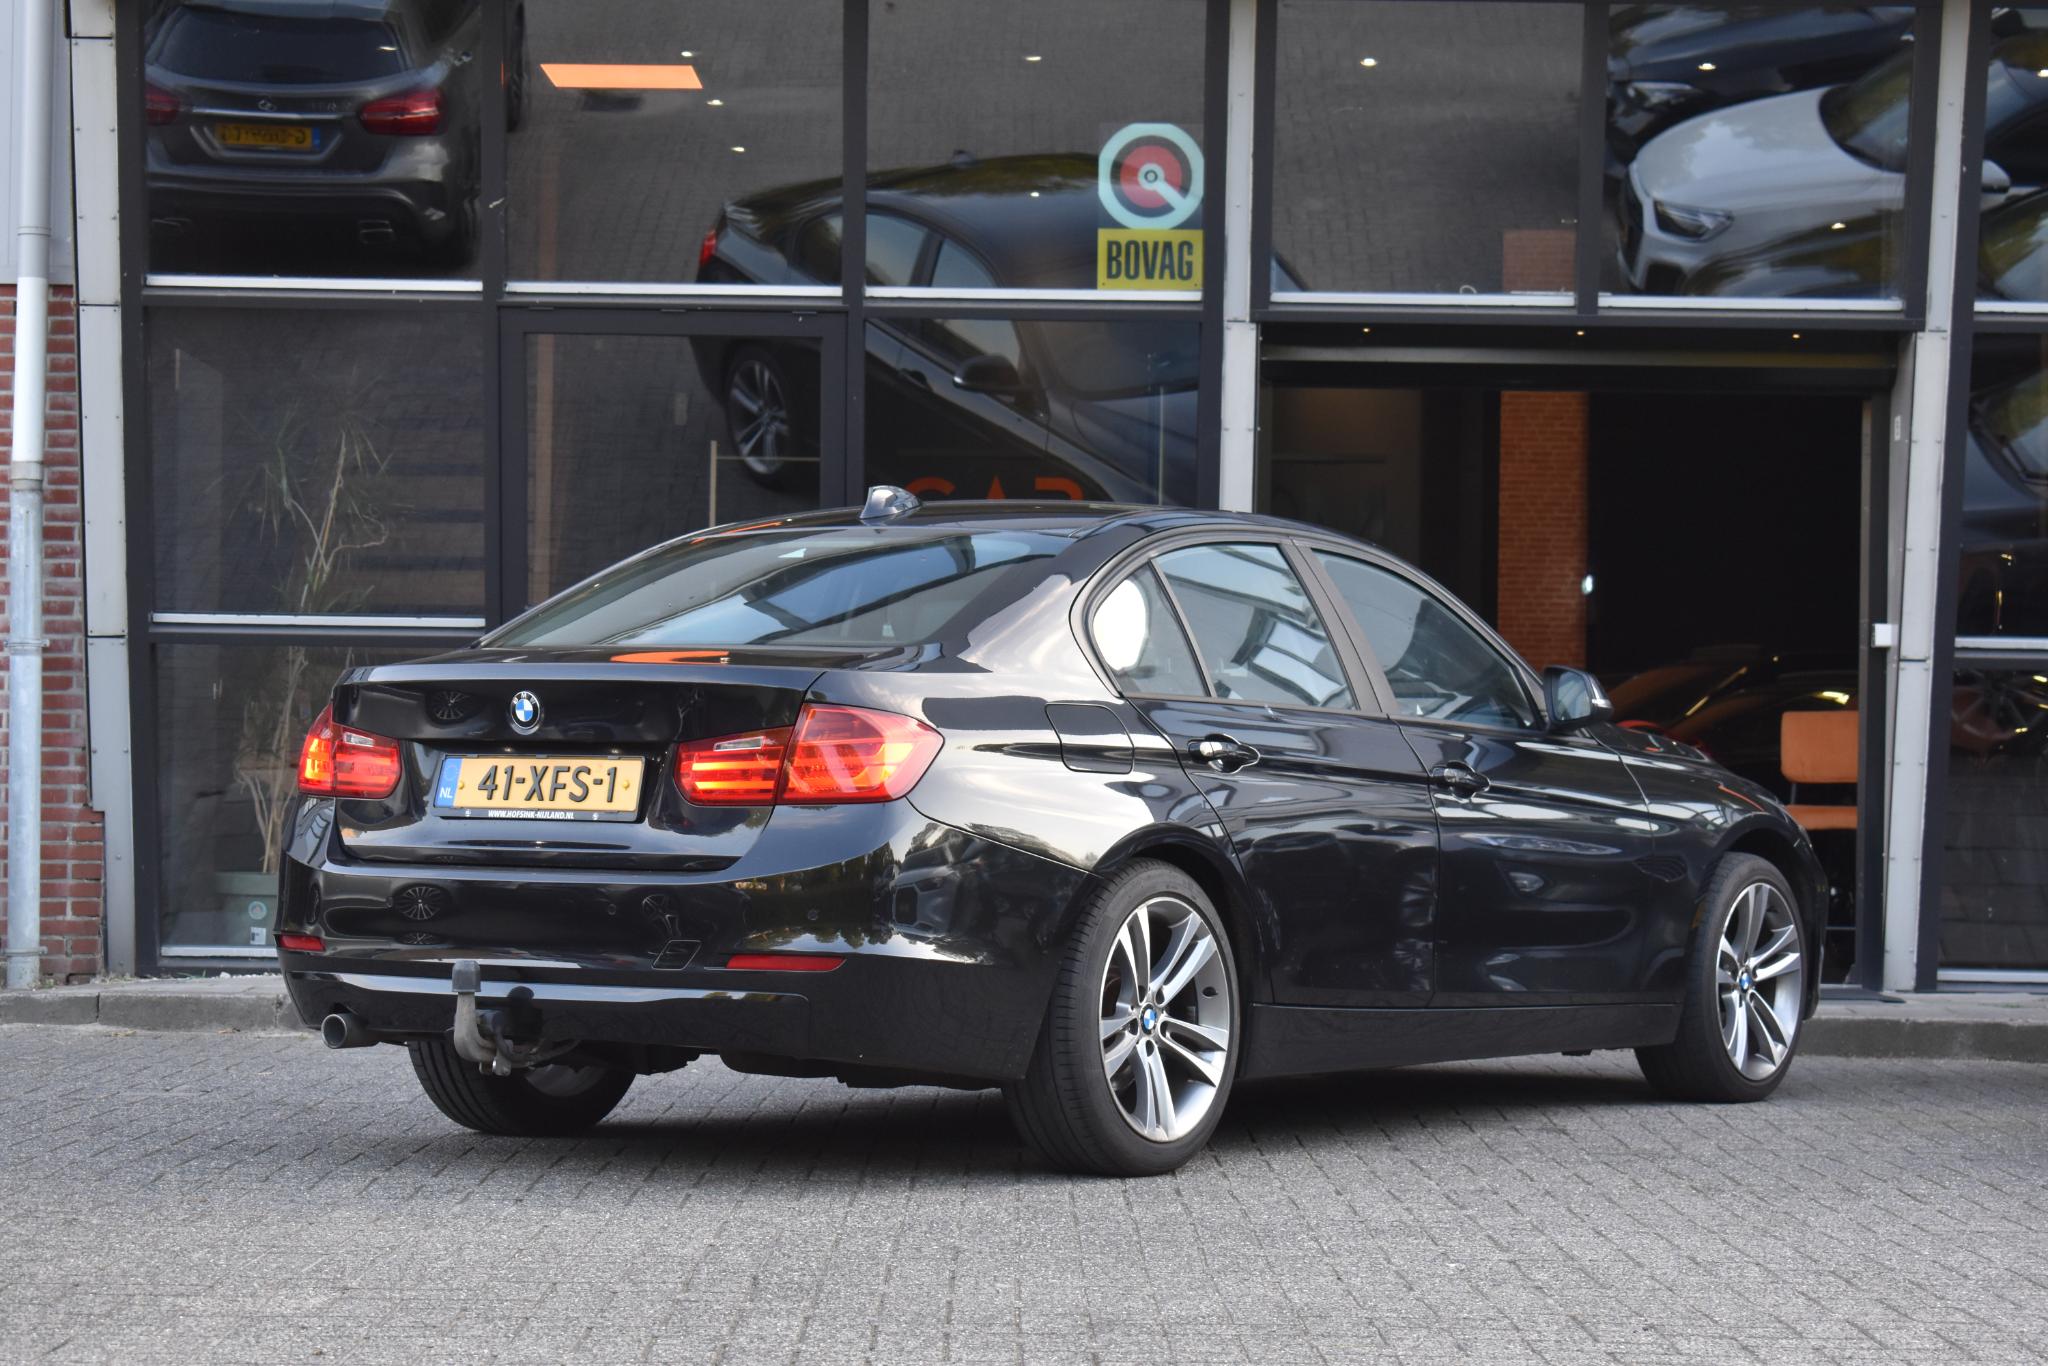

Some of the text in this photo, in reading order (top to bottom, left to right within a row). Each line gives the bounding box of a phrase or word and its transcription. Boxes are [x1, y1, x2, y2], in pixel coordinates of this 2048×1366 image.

[1106, 240, 1194, 281] BOVAG
[439, 787, 453, 799] NL
[478, 765, 617, 803] 41-XFS-1
[488, 809, 574, 819] WWW.HOFSINK-NIJLAND.NL
